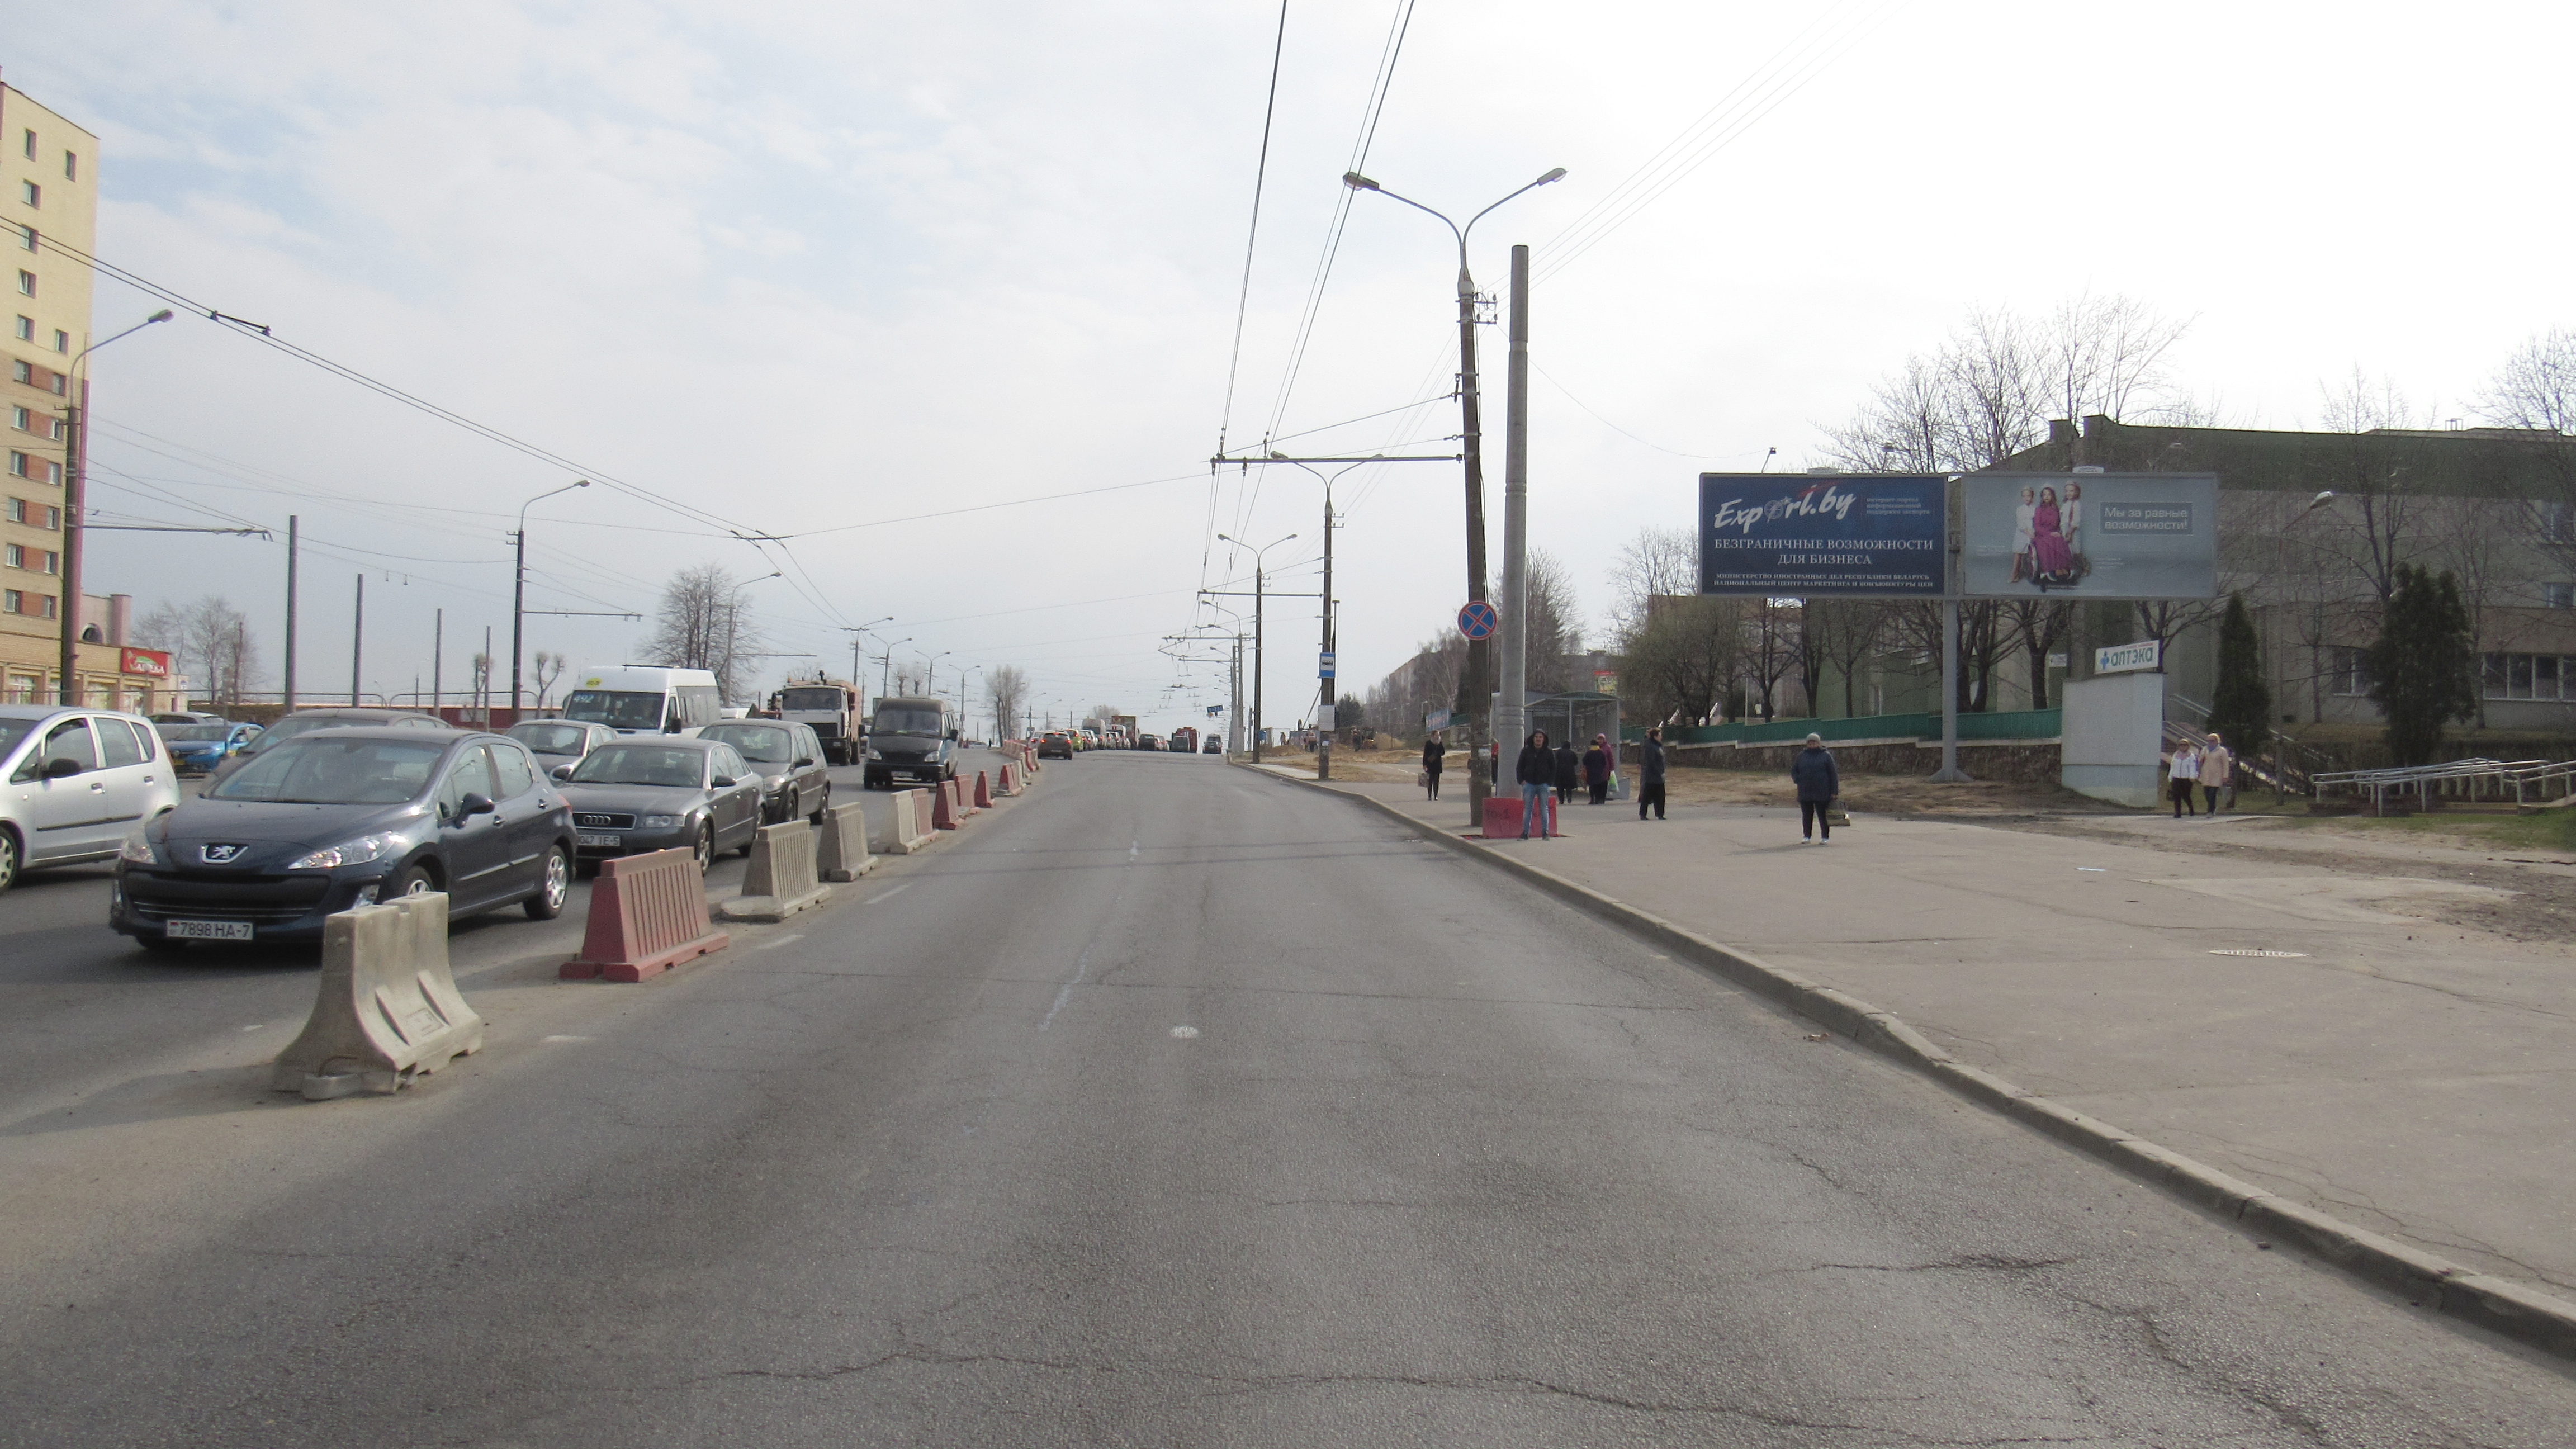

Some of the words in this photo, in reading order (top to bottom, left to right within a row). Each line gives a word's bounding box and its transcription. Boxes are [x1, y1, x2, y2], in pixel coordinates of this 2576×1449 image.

[2105, 507, 2124, 517] Мы
[2144, 509, 2187, 519] равные
[2105, 519, 2187, 529] возможности!
[1715, 539, 1824, 549] БЕЗГРАНИЧНЫЕ
[1827, 540, 1934, 550] ВОЗМОЖНОСТИ
[1777, 555, 1806, 565] ДЛЯ
[1810, 555, 1872, 565] БИЗНЕСА
[2111, 647, 2153, 666] аптэка
[135, 663, 165, 673] АПЕКА
[180, 922, 212, 936] 7898
[216, 924, 250, 937] HA-7
